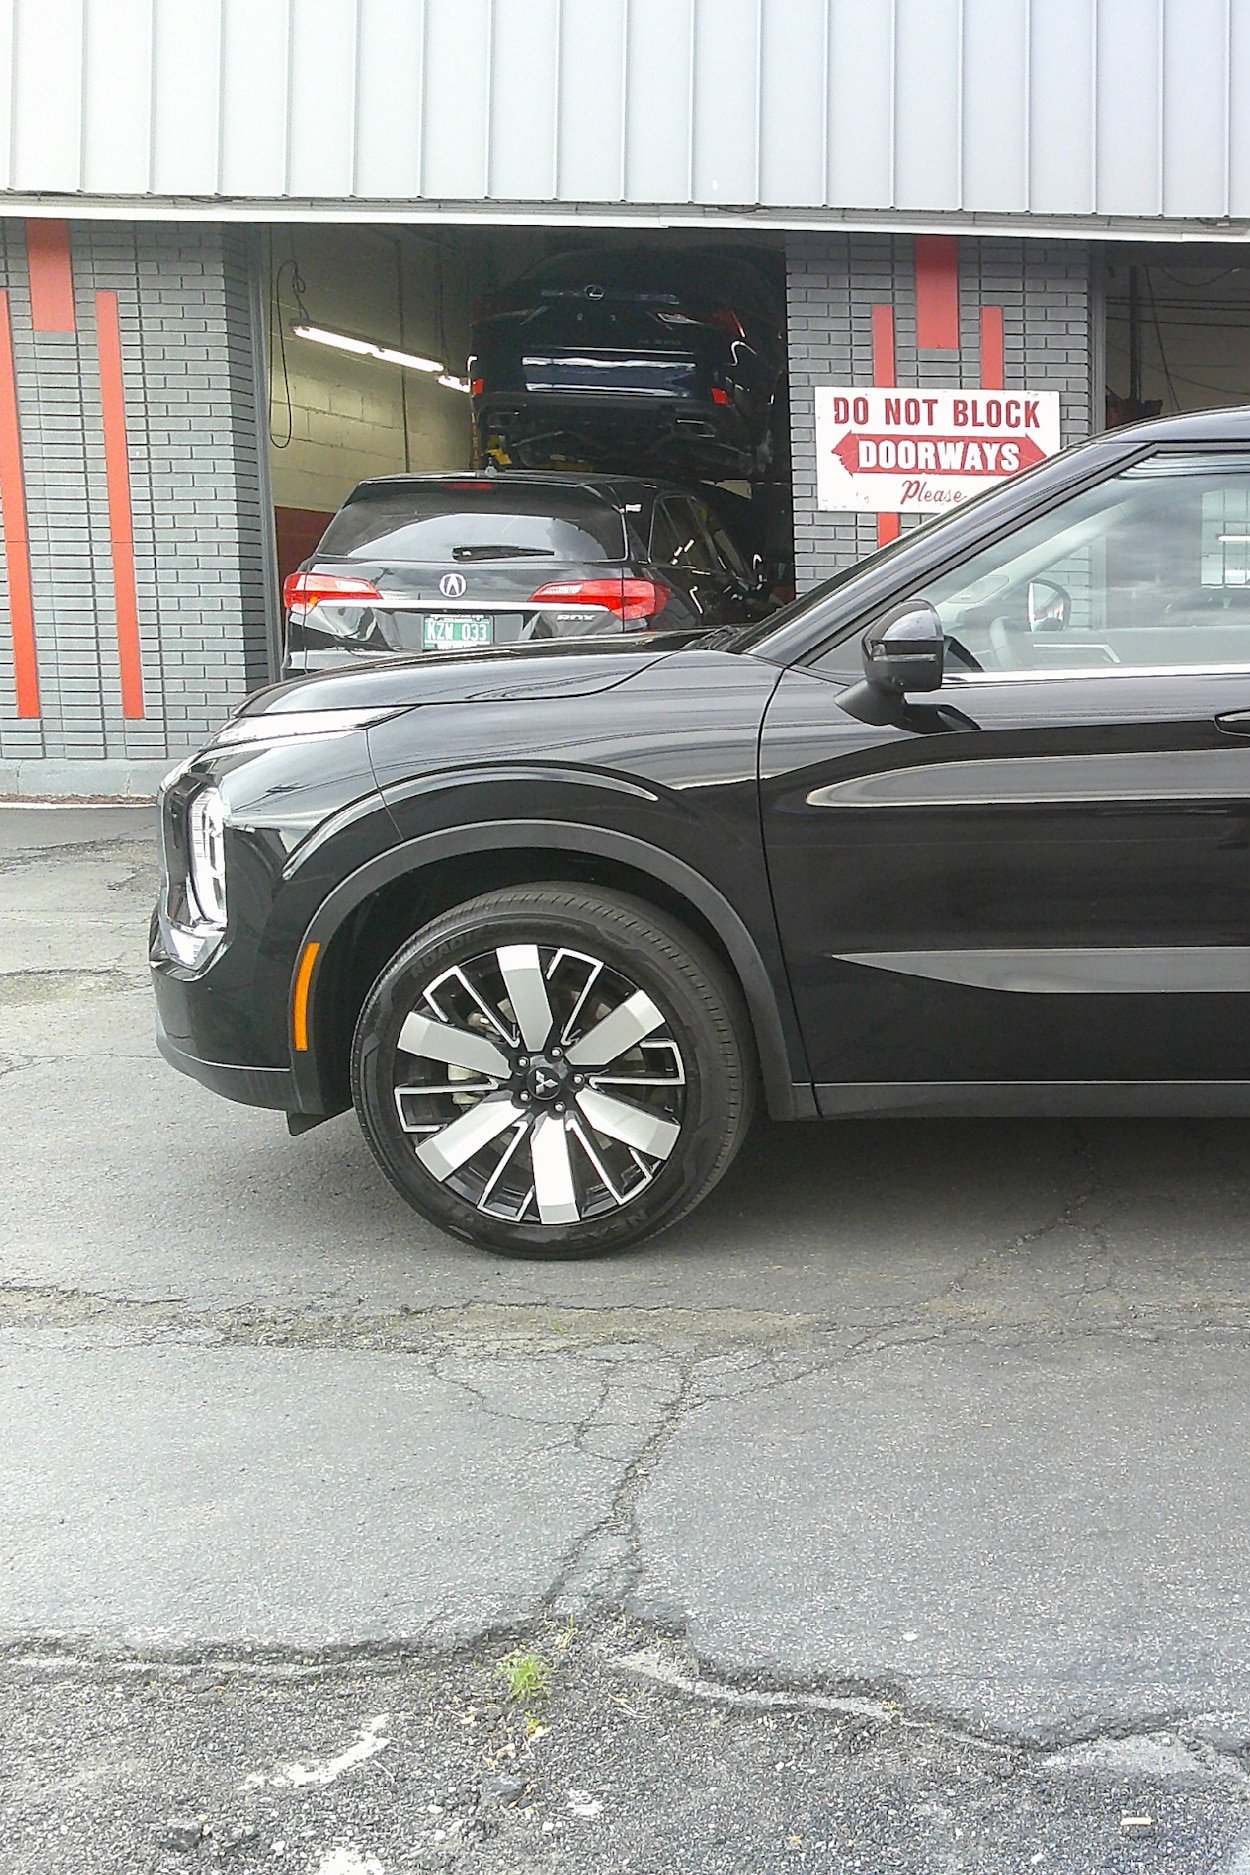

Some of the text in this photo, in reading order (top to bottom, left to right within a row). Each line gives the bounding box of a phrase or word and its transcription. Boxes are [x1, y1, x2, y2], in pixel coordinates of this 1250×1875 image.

[834, 397, 1040, 428] DO NOT BLOCK
[858, 440, 1020, 472] DOORWAYS
[900, 480, 967, 505] Please
[426, 622, 488, 641] KZW 033
